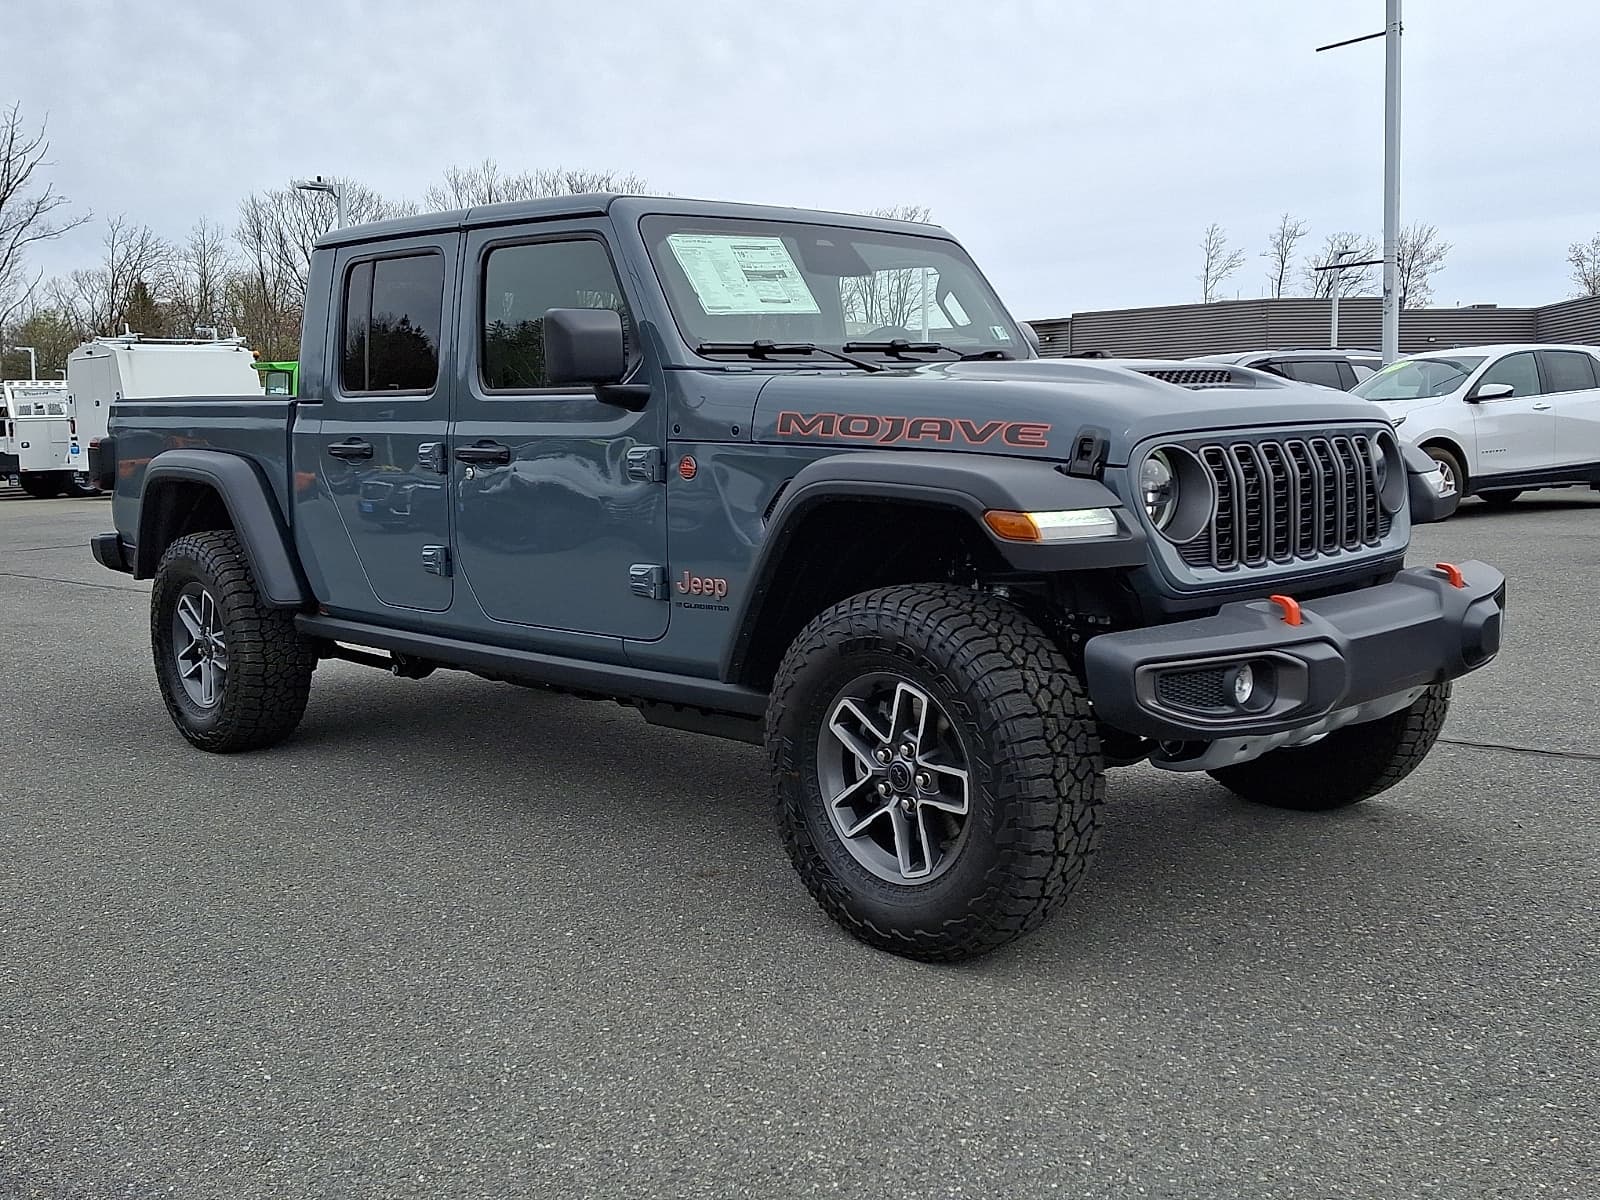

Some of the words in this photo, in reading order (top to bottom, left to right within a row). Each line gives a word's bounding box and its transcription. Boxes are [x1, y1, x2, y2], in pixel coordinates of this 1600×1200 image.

[777, 411, 1051, 448] MOJAVE
[676, 571, 728, 601] Jeep
[683, 602, 730, 612] GLADIATOR
